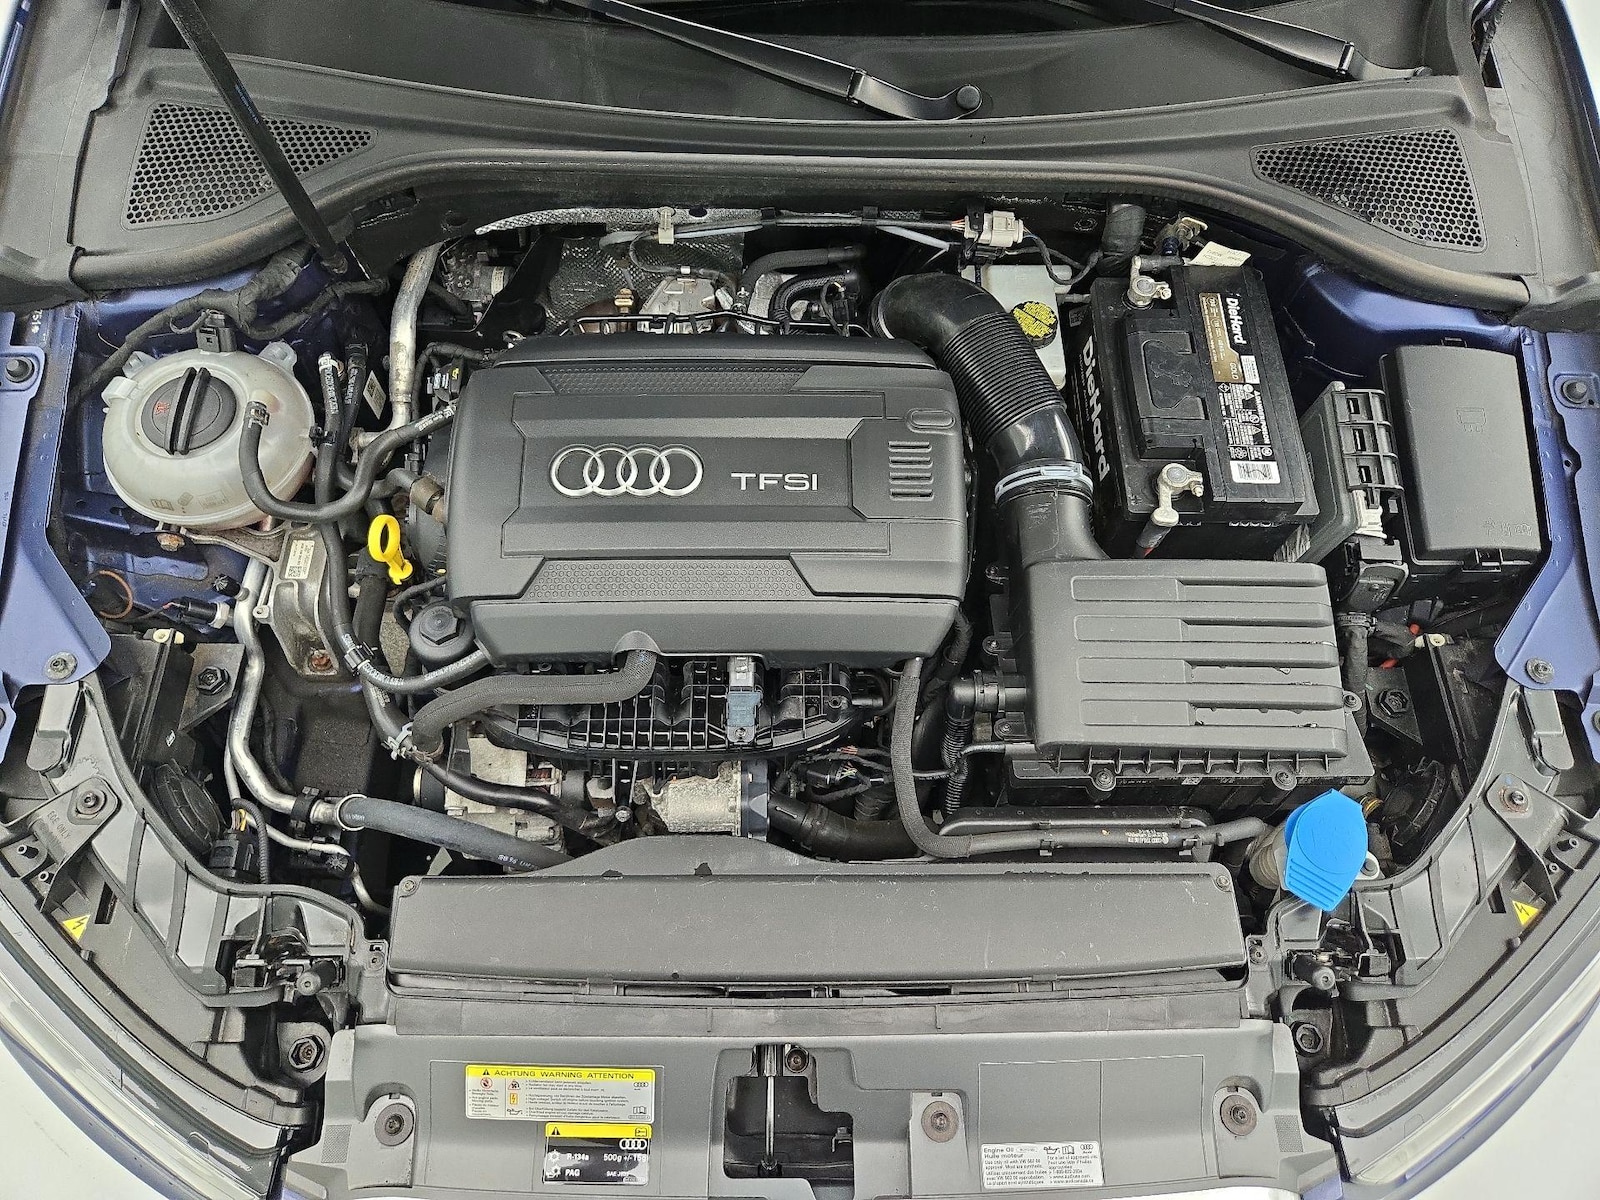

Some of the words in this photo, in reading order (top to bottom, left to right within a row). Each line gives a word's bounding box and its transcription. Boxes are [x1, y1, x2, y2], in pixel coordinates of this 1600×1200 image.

[1226, 297, 1247, 345] DieHard
[1229, 362, 1239, 380] GOLD
[1083, 335, 1110, 482] DieHard
[730, 472, 818, 491] TFSI
[56, 823, 72, 840] ONLY
[494, 1069, 536, 1077] ACHTUNG
[540, 1071, 583, 1079] WARNING
[587, 1072, 634, 1080] ATTENTION
[566, 1153, 590, 1161] R-134a
[603, 1153, 622, 1163] 500g
[564, 1168, 581, 1177] PAG
